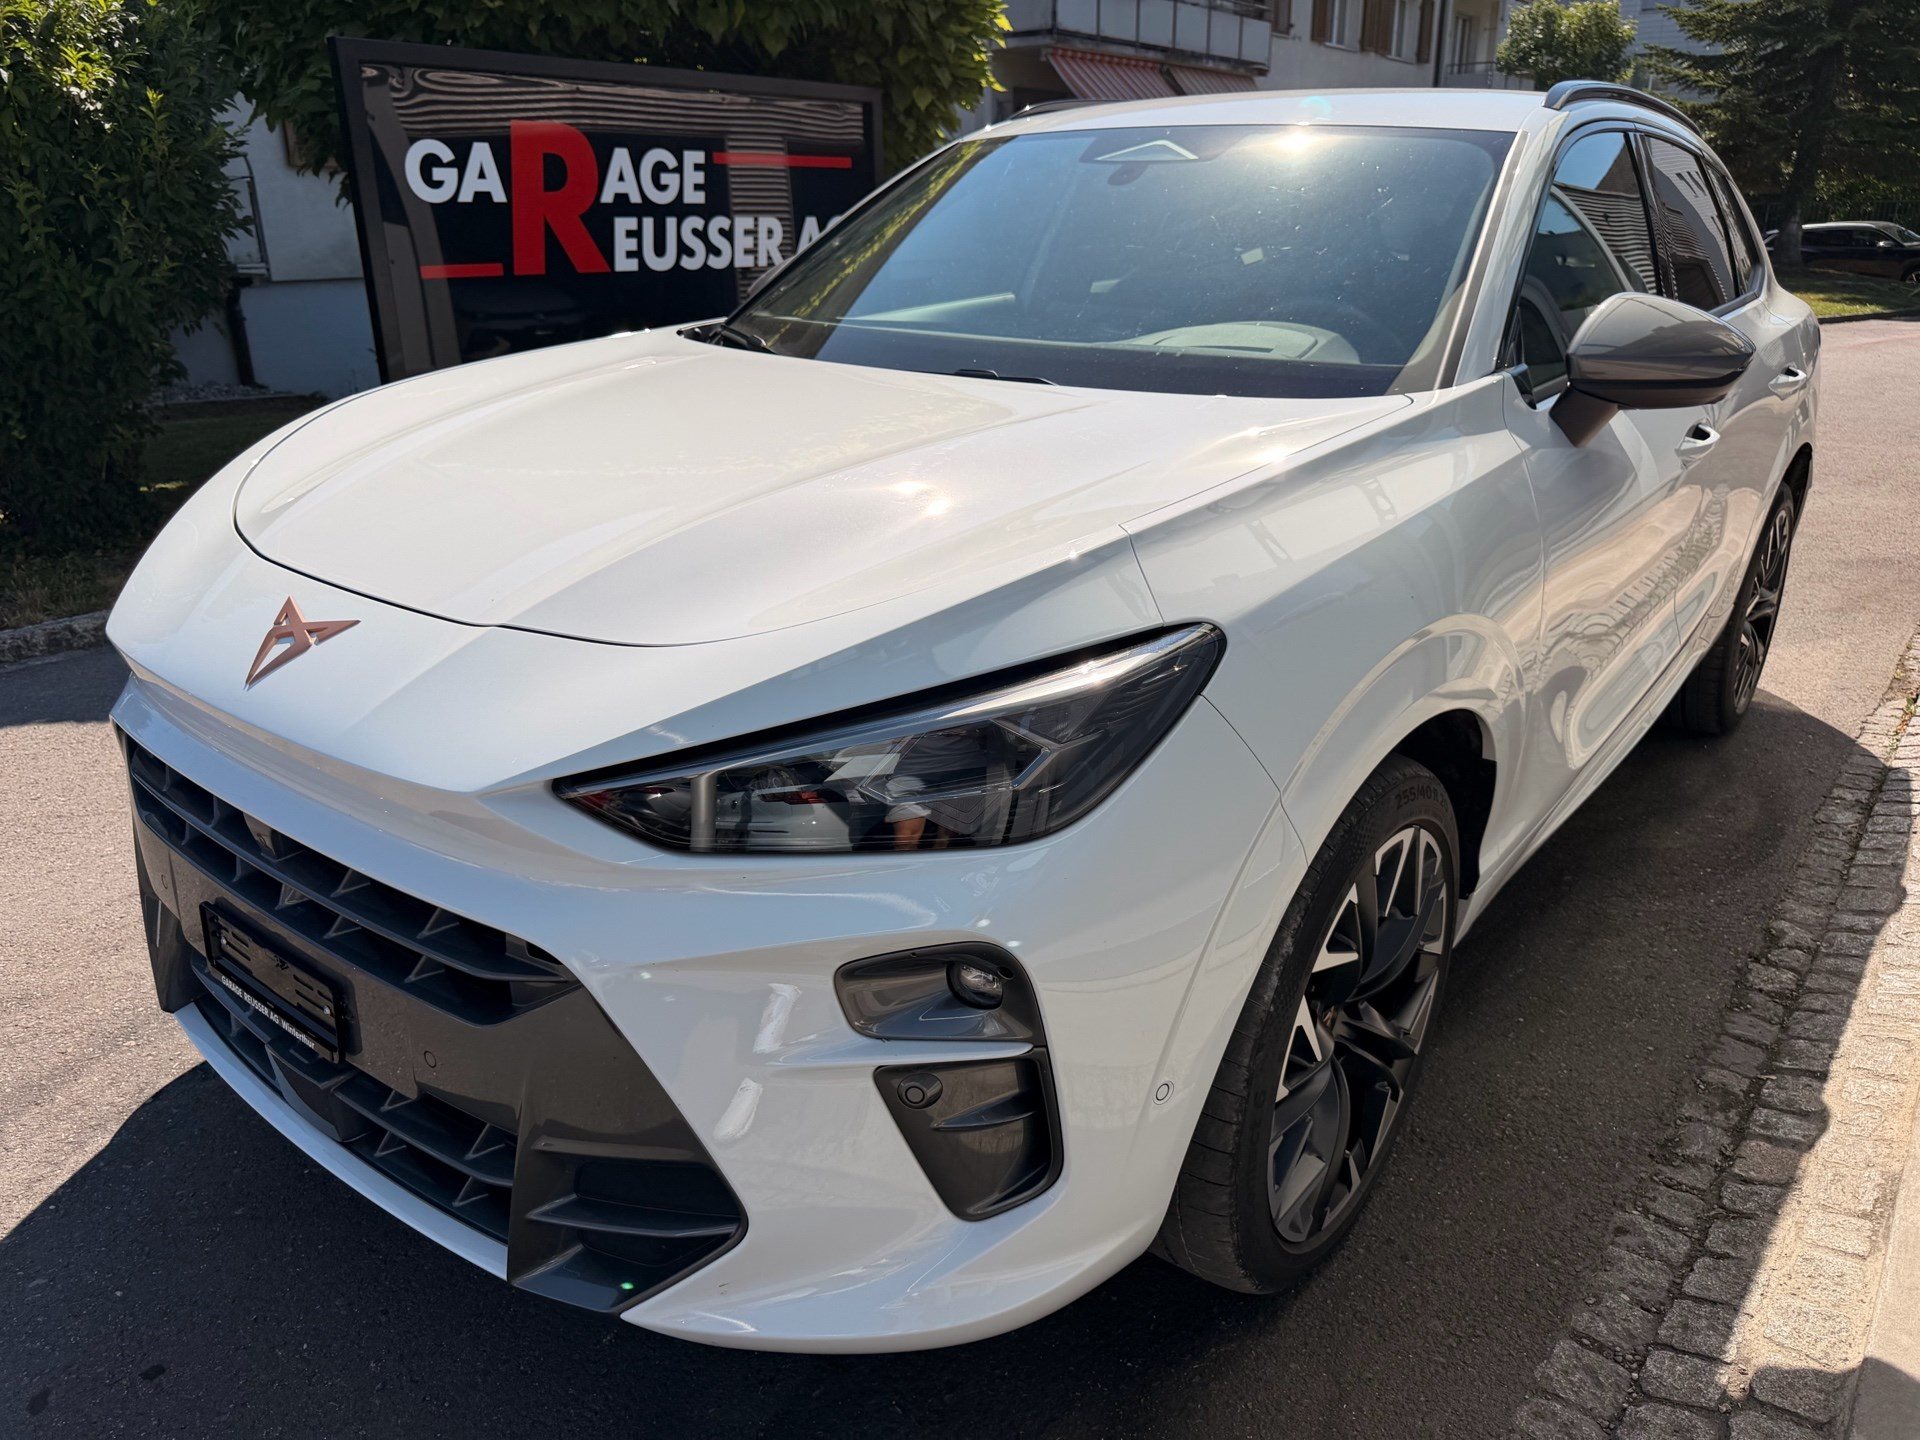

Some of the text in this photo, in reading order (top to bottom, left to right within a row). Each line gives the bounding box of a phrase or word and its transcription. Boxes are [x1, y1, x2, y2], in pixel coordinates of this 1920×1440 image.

[404, 119, 706, 276] GARAGE
[221, 974, 243, 998] GARAGE
[243, 991, 270, 1018] REUSSER
[281, 1019, 315, 1049] Winterthur
